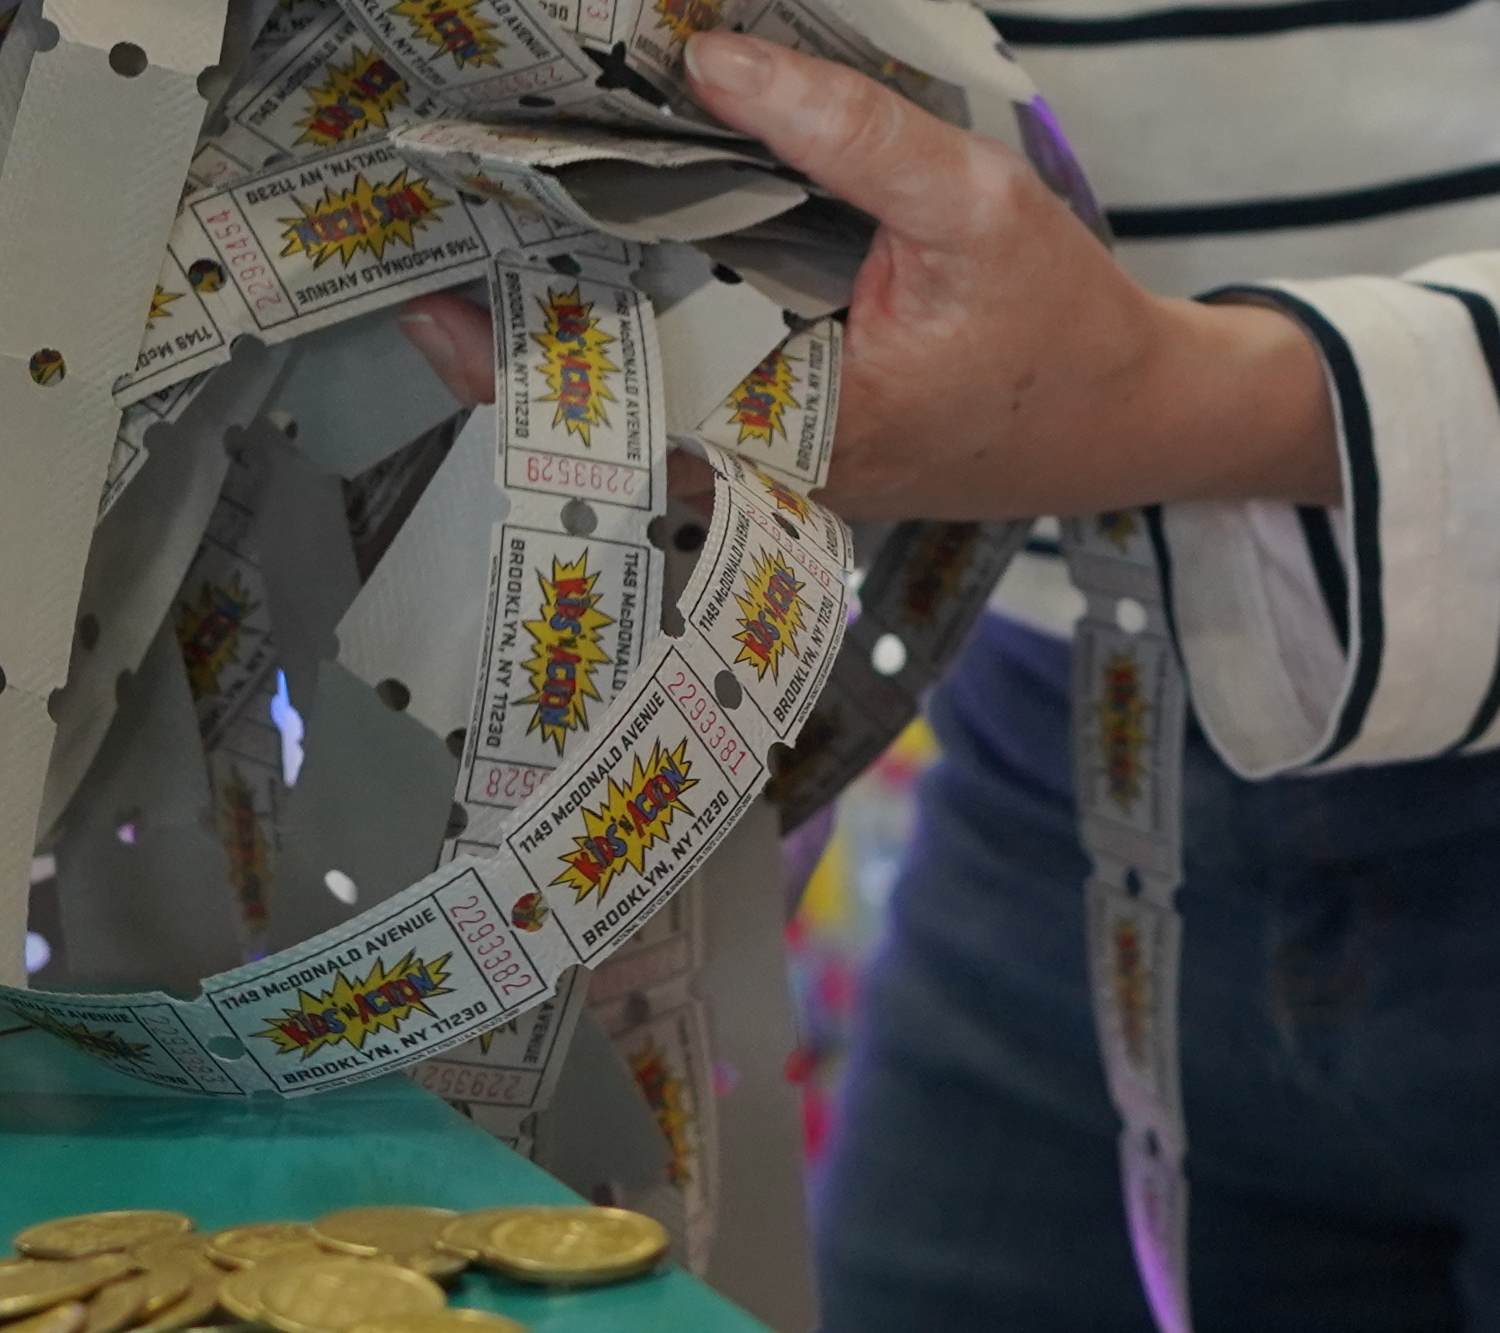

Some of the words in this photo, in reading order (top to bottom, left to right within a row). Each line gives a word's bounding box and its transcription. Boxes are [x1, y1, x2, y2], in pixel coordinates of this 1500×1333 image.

[246, 179, 297, 205] 11230
[299, 169, 323, 188] NY
[296, 278, 358, 305] AVENUE
[357, 248, 446, 285] McDONALD
[515, 362, 528, 385] NY
[515, 394, 529, 438] 11230
[625, 400, 641, 462] AVENUE
[527, 457, 636, 494] 2293529
[497, 538, 525, 653] BROOKLYN,
[622, 552, 638, 587] 1149
[699, 603, 720, 632] 1149
[718, 546, 744, 603] McDONALD
[736, 511, 751, 549] AVENUE
[550, 578, 590, 636] KIDS
[818, 595, 835, 629] 11230
[612, 590, 636, 691] McDONALD
[811, 627, 826, 651] NY
[497, 660, 513, 688] NY
[539, 645, 582, 727] ACTION
[773, 650, 819, 724] BROOKLYN,
[487, 692, 508, 748] 11230
[666, 672, 747, 776] 2293381
[519, 821, 554, 854] 1149
[552, 746, 623, 827] McDONALD
[622, 691, 666, 752] AVENUE
[573, 824, 628, 884] KIDS
[625, 756, 686, 838] ACTION
[581, 857, 675, 947] BROOKLYN,
[672, 831, 695, 862] NY
[693, 789, 729, 830] 11230
[221, 991, 261, 1010] 1149
[264, 948, 362, 998] McDONALD
[366, 908, 437, 955] AVENUE
[449, 895, 532, 996] 2293382
[65, 1009, 134, 1024] AVENUE
[280, 1008, 347, 1046] KIDS
[353, 964, 434, 1025] ACTION
[283, 1041, 400, 1085] BROOKLYN,
[401, 1029, 428, 1048] NY
[430, 1000, 489, 1035] 11230
